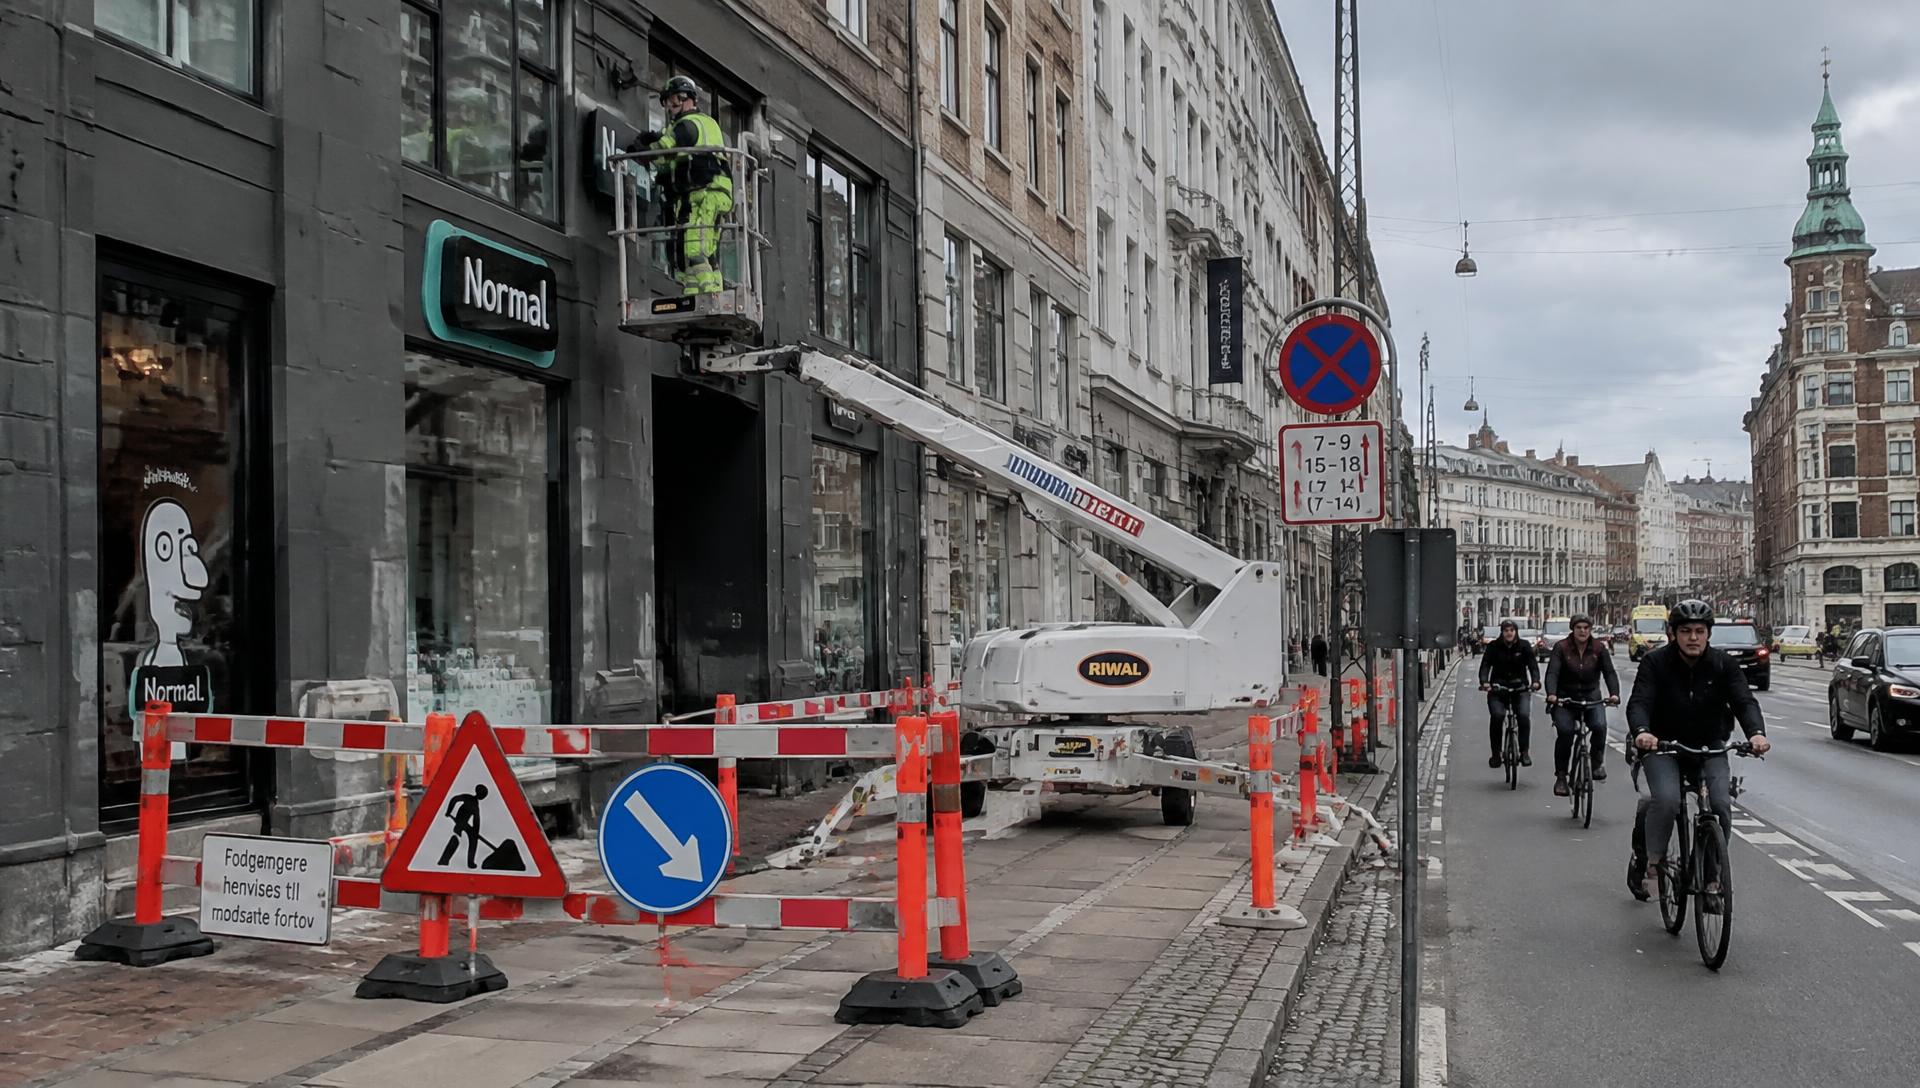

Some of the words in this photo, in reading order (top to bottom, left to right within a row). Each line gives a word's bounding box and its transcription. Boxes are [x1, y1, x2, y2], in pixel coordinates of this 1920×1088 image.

[464, 256, 550, 330] Normal
[1314, 434, 1351, 451] 7-9
[1305, 456, 1361, 474] 15-18
[1307, 496, 1361, 516] (7-14)
[1088, 662, 1142, 676] RIWAL
[223, 876, 281, 899] henvises
[274, 908, 315, 929] fortov
